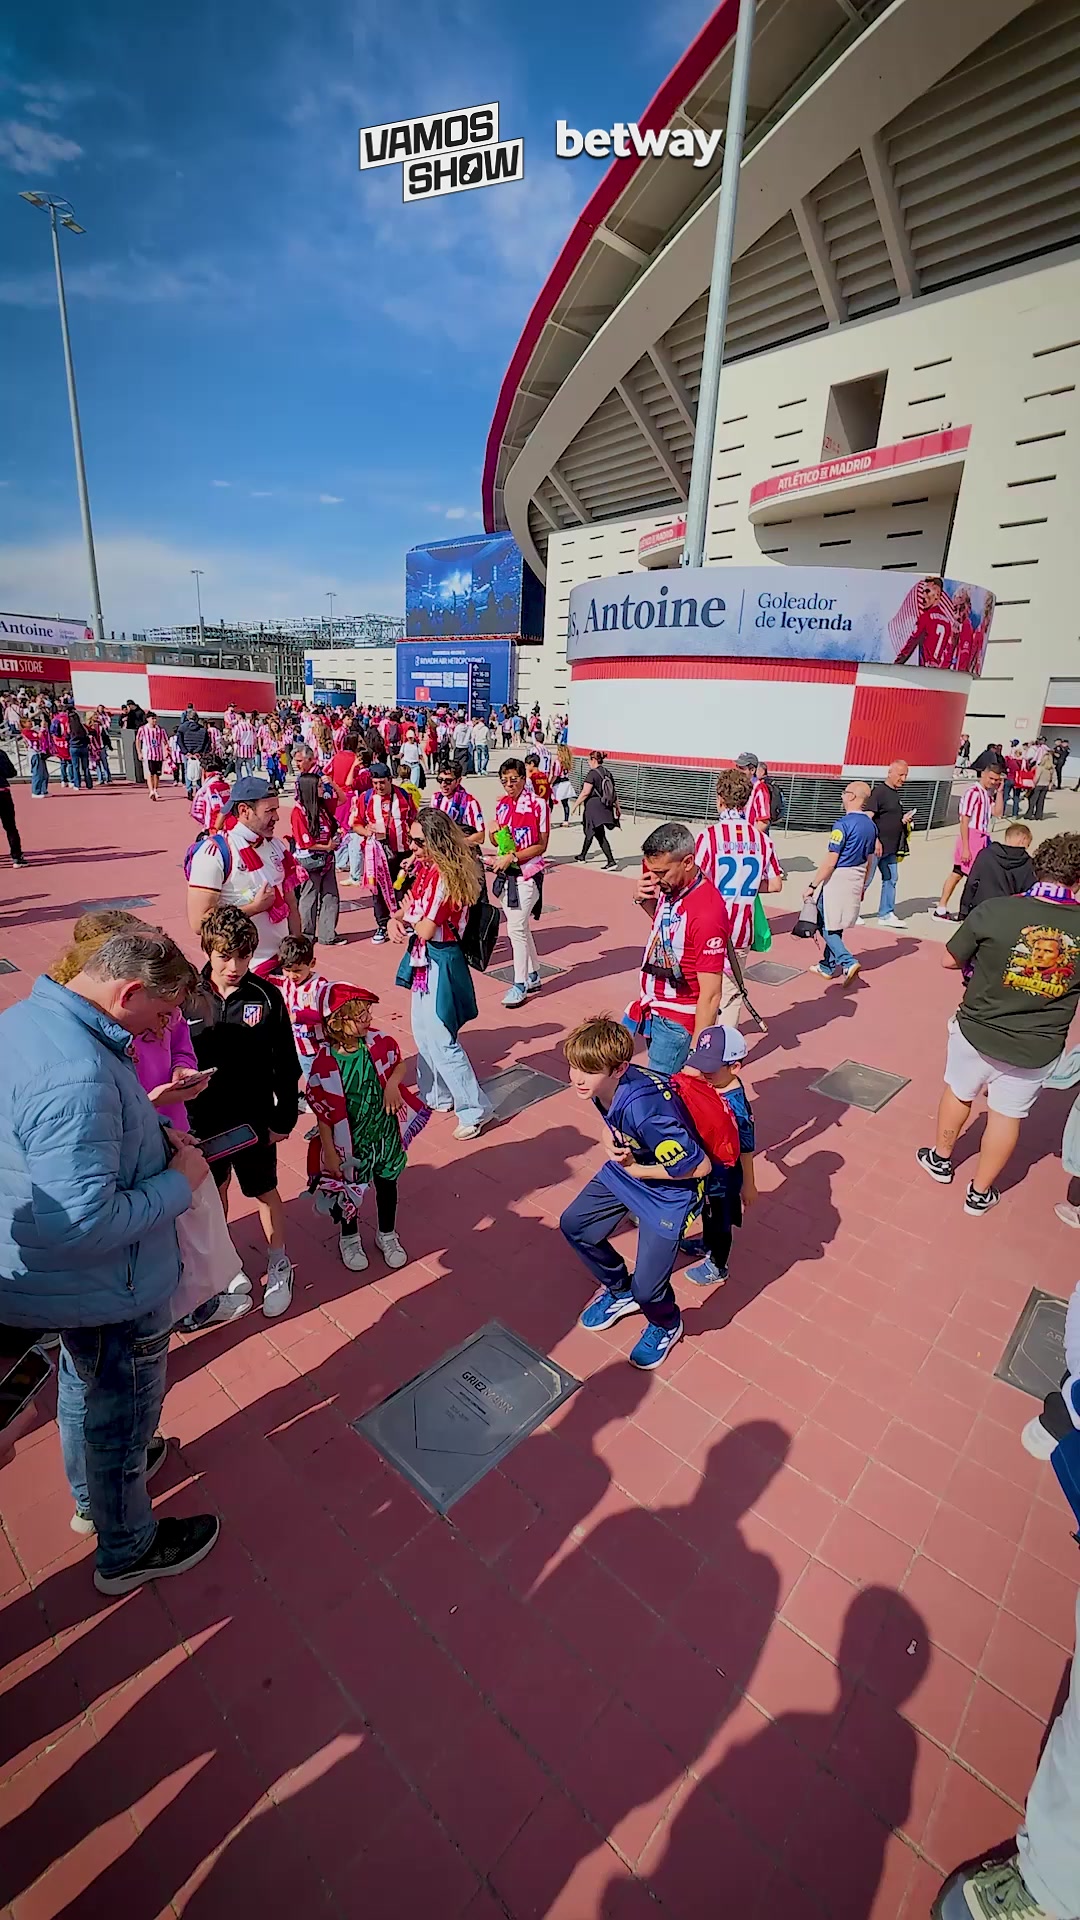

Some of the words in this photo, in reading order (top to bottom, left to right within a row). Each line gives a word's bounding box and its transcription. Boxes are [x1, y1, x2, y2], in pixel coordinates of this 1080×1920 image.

[778, 470, 820, 490] ATLÉTICO
[829, 456, 872, 478] MADRID
[583, 586, 726, 634] Antoine
[757, 592, 838, 610] Goleador
[0, 620, 54, 638] Antoine
[755, 611, 776, 628] de
[780, 613, 853, 635] leyenda
[19, 660, 44, 673] STORE
[718, 856, 760, 897] 22
